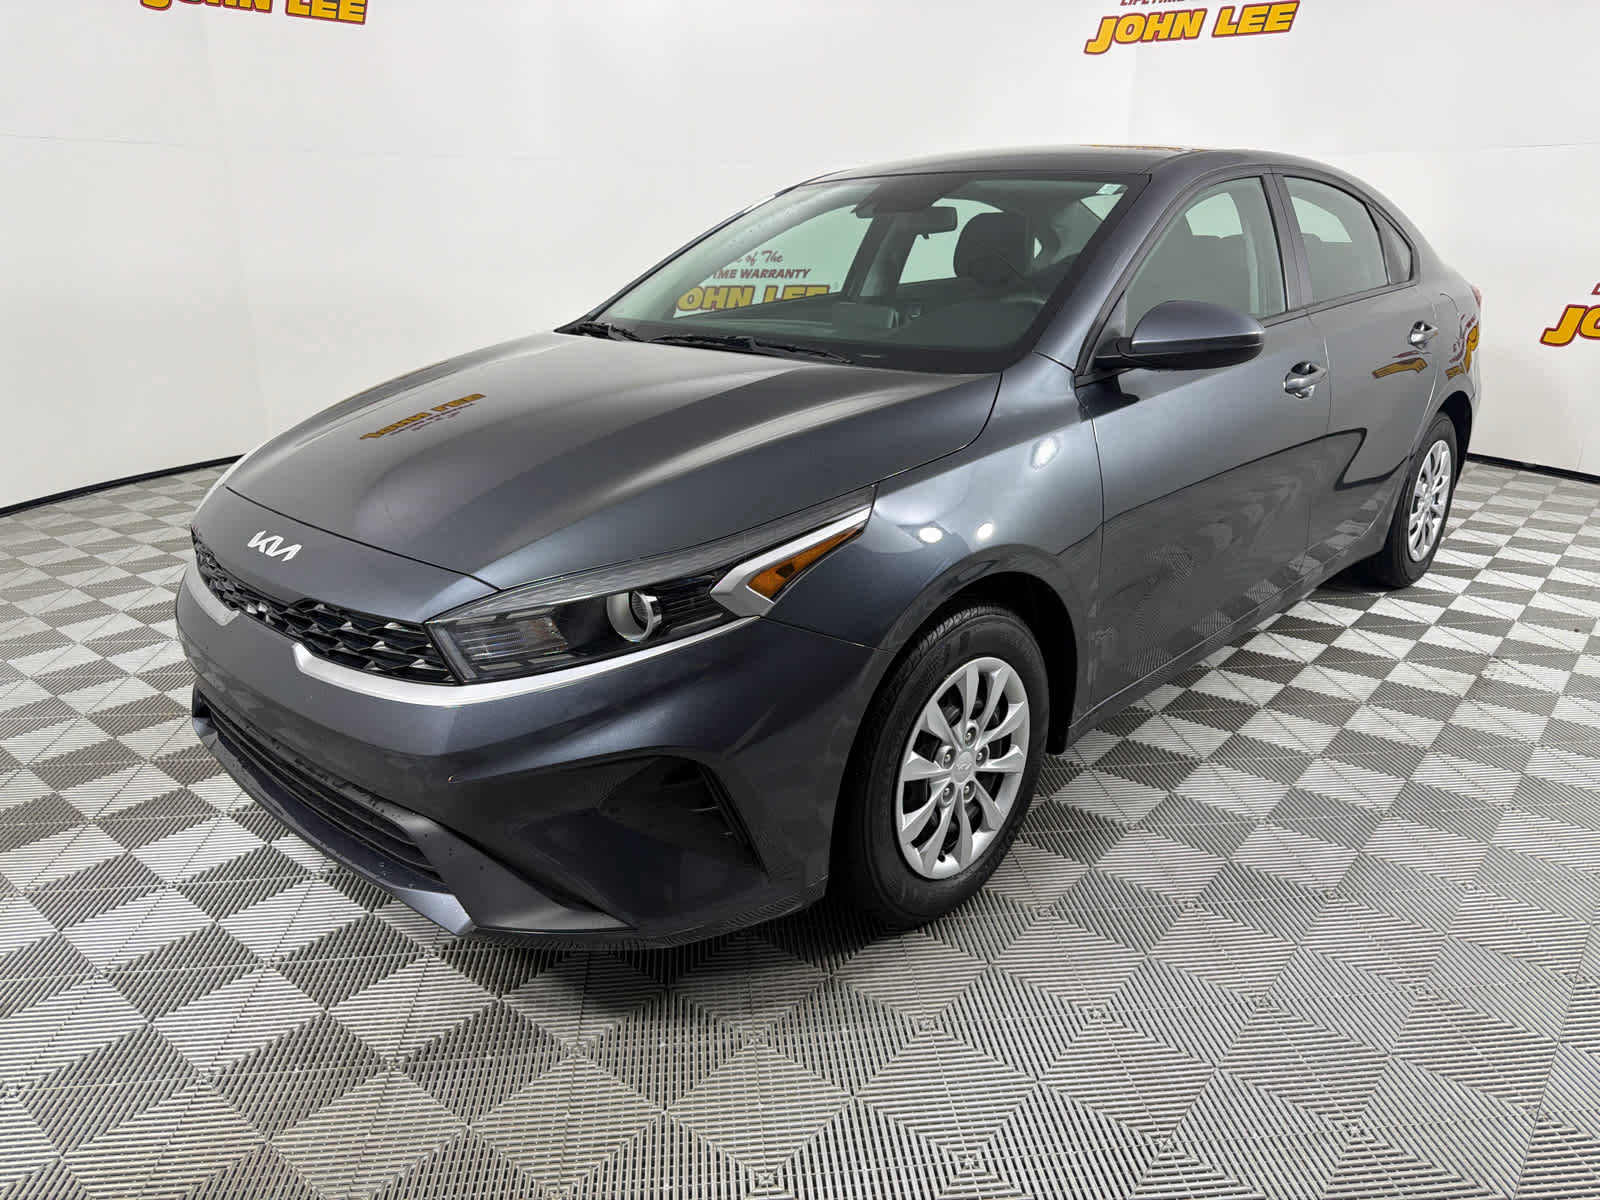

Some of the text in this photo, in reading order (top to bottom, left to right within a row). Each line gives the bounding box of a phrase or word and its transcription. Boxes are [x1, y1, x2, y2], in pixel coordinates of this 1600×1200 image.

[1084, 0, 1299, 55] JOHN LEE
[761, 250, 784, 263] The
[740, 268, 811, 279] WARRANTY
[677, 285, 755, 310] OHN
